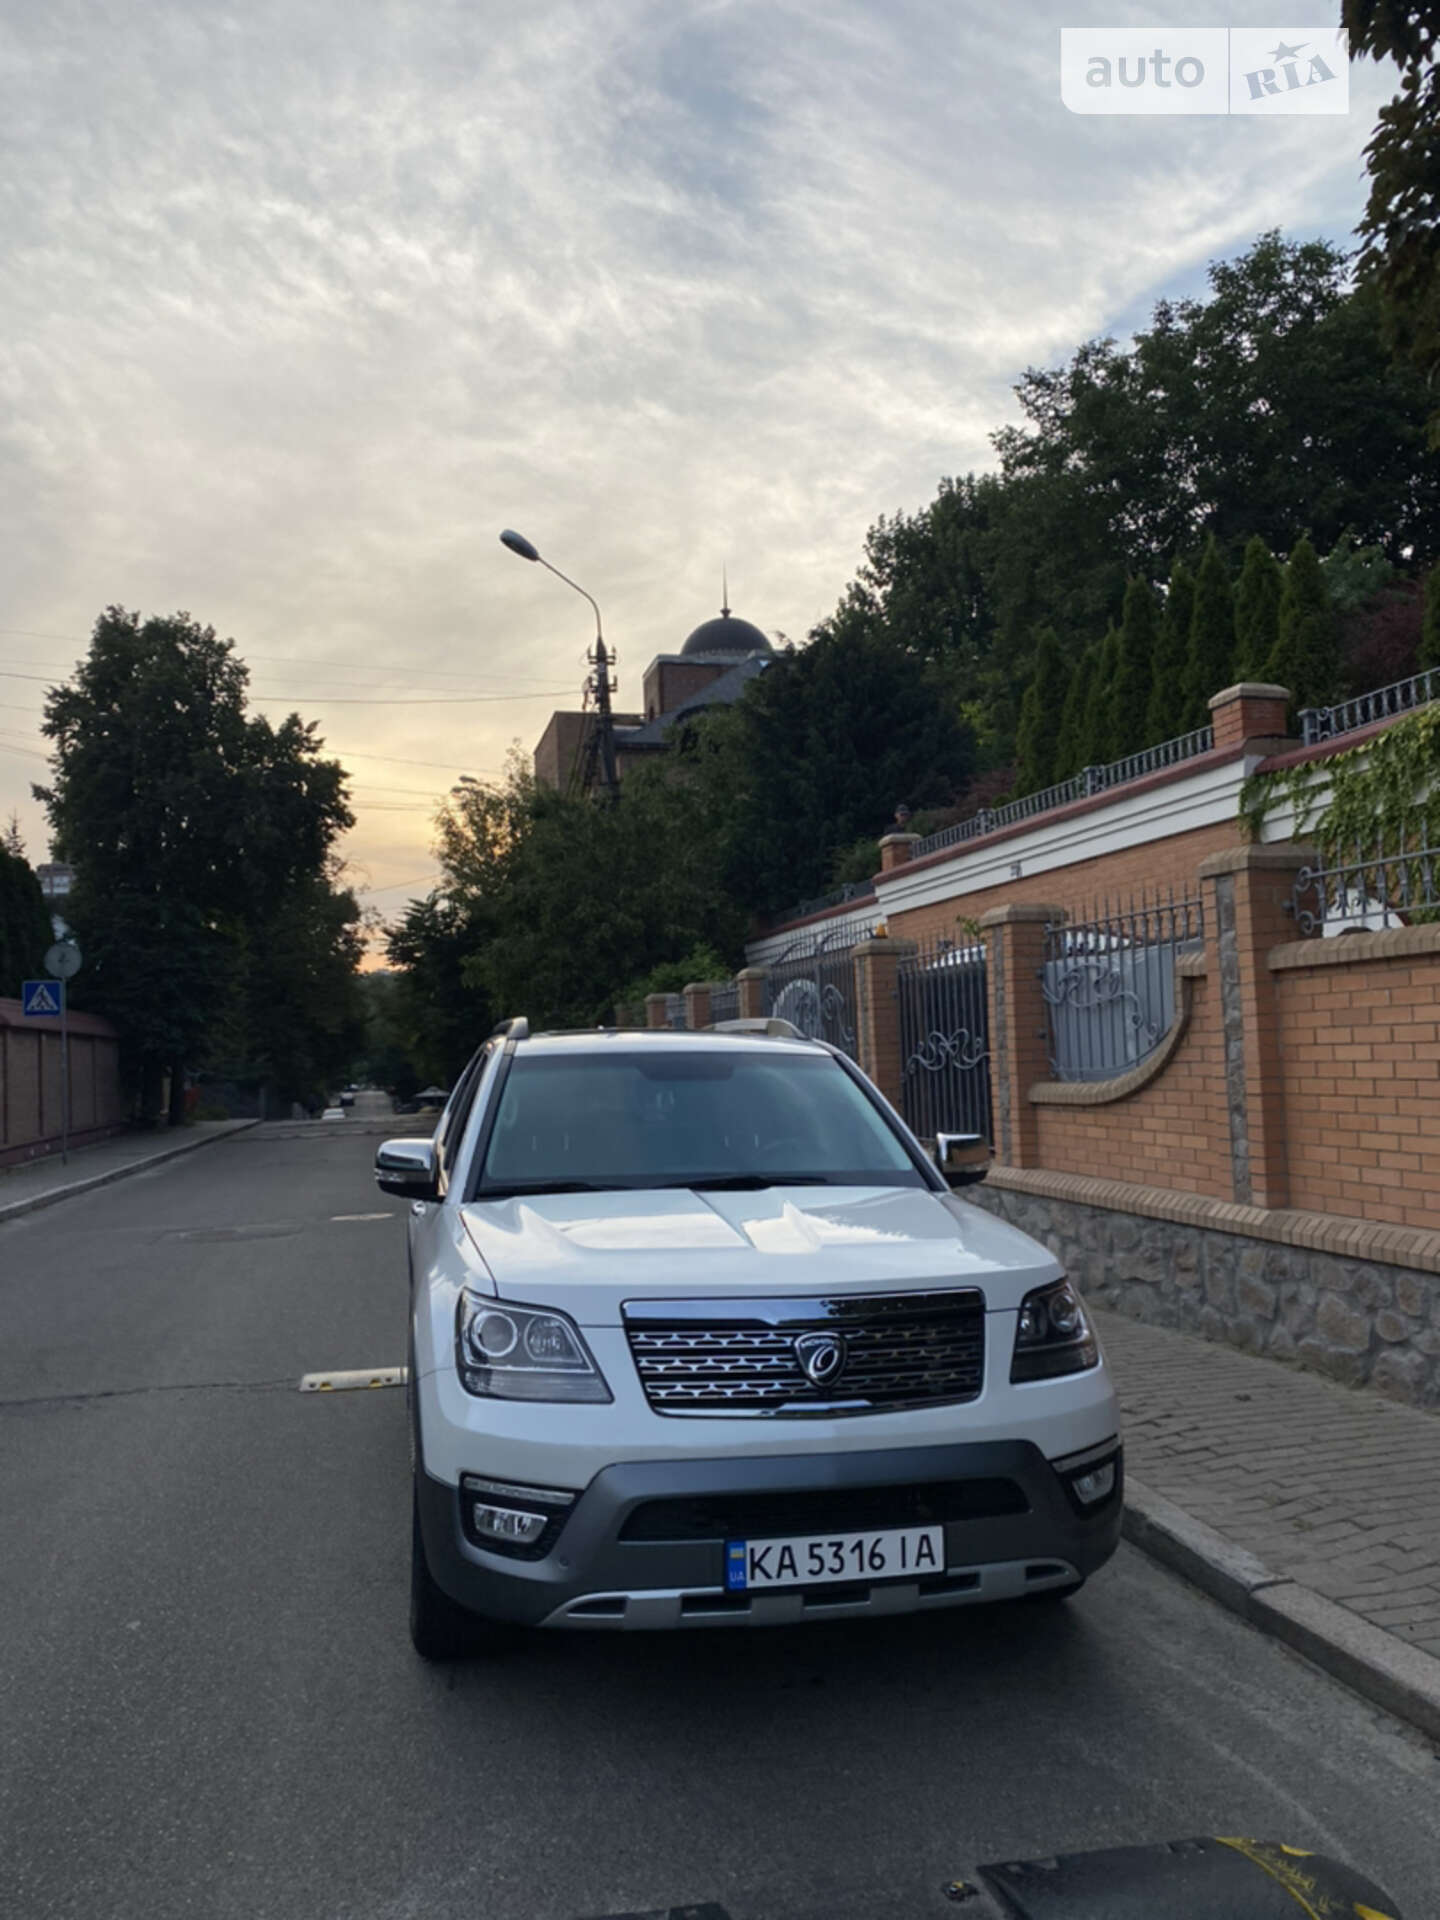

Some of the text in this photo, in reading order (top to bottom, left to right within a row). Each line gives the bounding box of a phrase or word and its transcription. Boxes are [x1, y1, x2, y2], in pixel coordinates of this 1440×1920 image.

[749, 1533, 937, 1581] KA 5316 IA
[729, 1570, 746, 1583] UA
